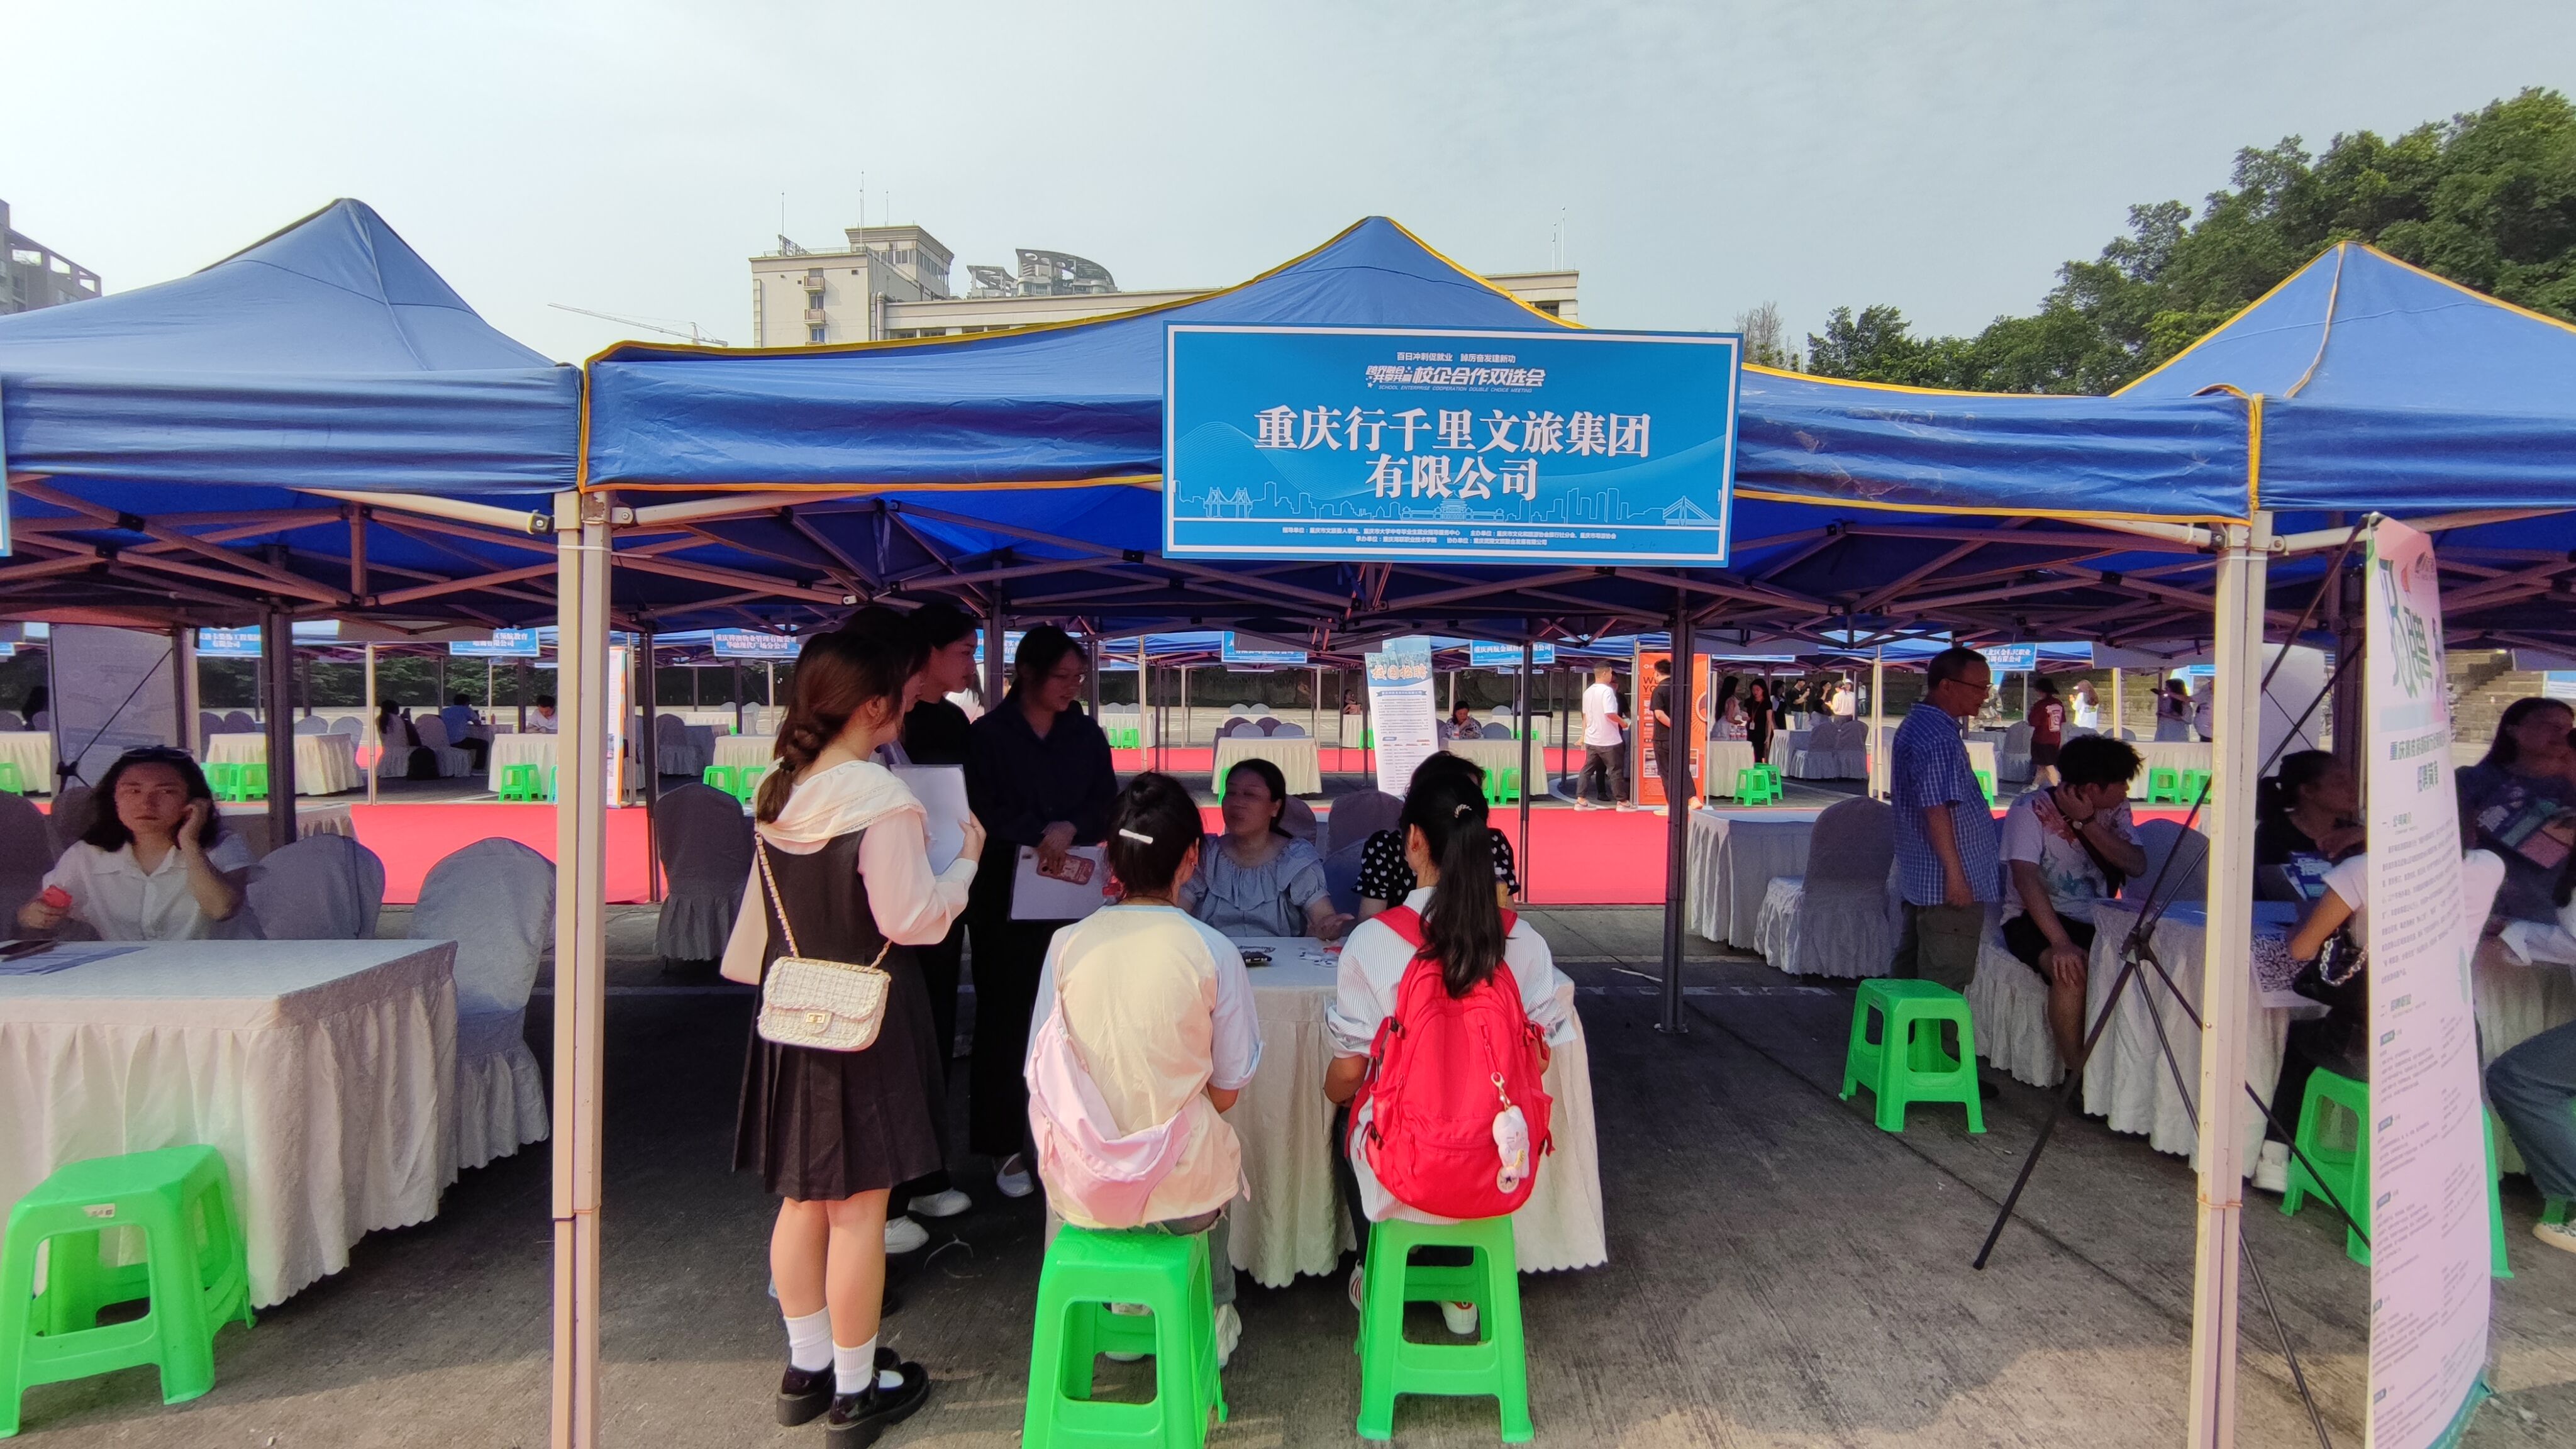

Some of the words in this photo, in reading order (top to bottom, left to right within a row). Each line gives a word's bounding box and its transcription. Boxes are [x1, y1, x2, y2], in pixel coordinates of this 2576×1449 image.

[1397, 352, 1453, 362] 百日冲刺促就业
[1413, 366, 1546, 387] 校企合作双选会
[1253, 404, 1650, 458] 重庆行千里文旅集团
[1365, 453, 1538, 501] 有限公司
[1371, 663, 1428, 680] 校园招聘
